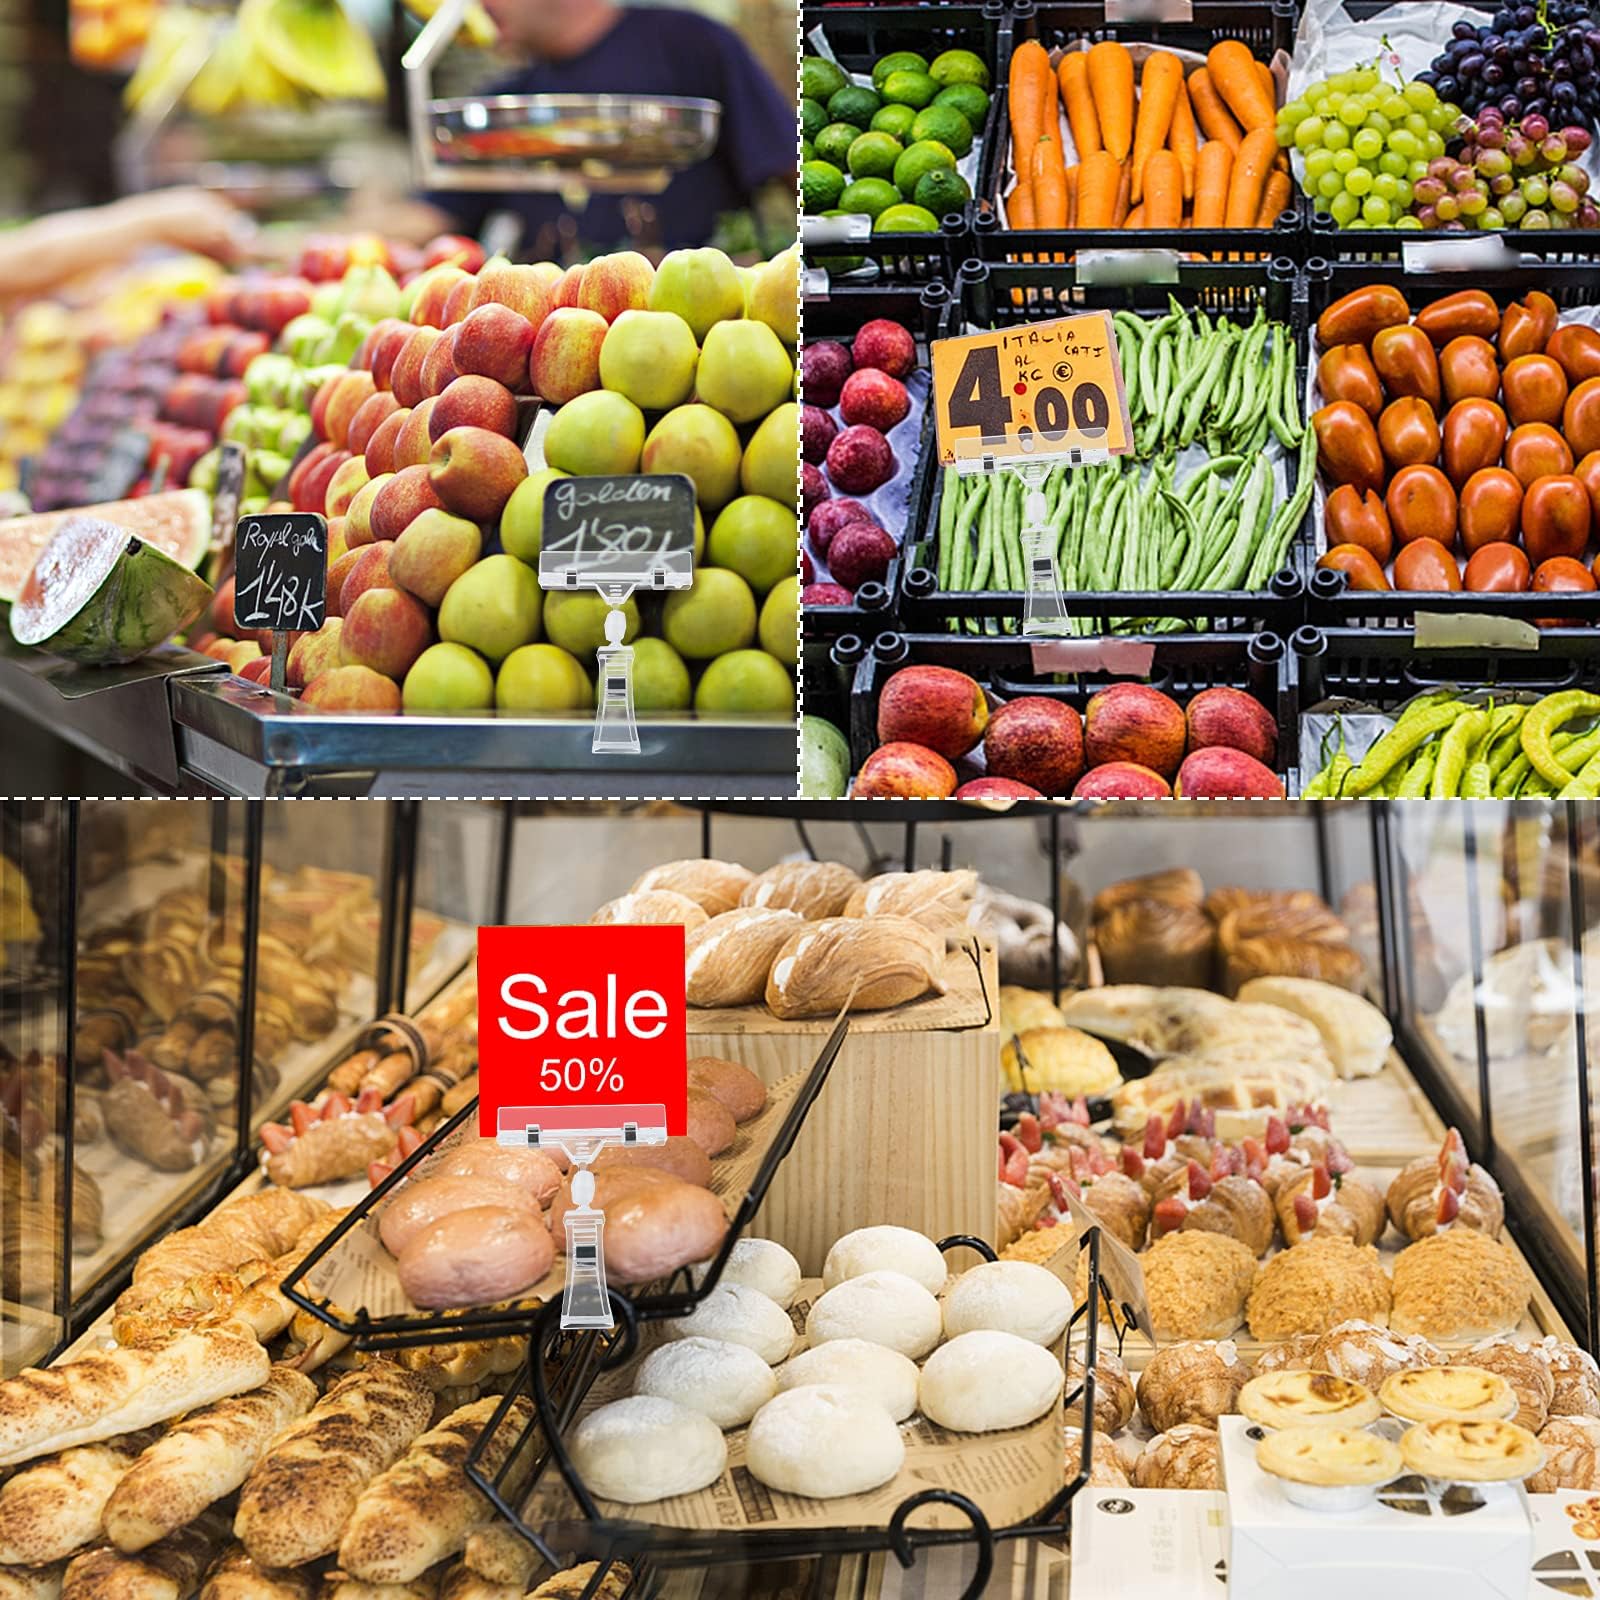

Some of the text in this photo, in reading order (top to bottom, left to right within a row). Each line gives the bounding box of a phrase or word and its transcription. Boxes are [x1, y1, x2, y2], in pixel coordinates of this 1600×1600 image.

[1003, 329, 1077, 350] ITALIA
[497, 973, 668, 1040] Sale
[539, 1057, 624, 1093] 50%
